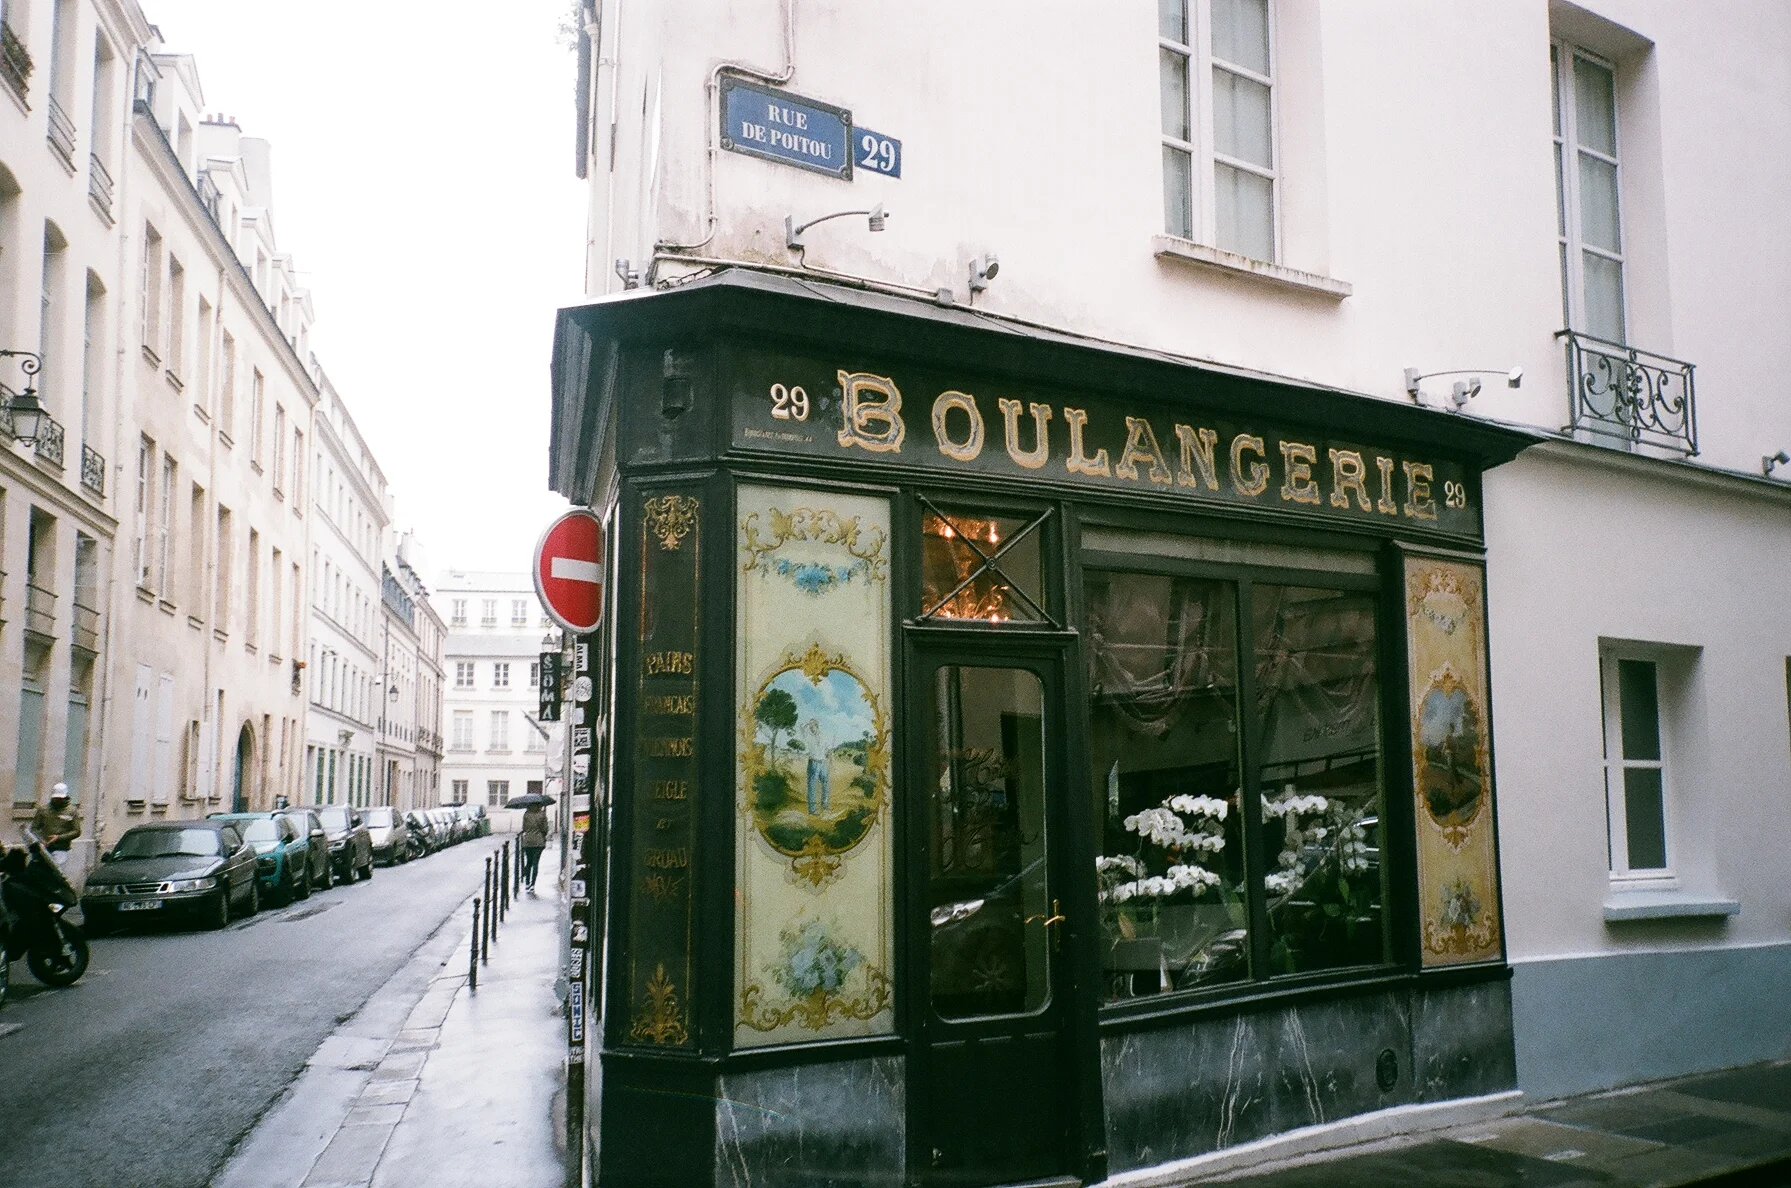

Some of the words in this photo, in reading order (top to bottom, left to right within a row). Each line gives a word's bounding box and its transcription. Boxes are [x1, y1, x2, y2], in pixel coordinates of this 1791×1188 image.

[767, 104, 807, 130] RUE
[742, 121, 767, 143] DE
[770, 129, 832, 160] POITOU
[861, 135, 896, 172] 29
[770, 383, 810, 422] 29
[837, 369, 1438, 520] BOULANGERIE
[1444, 480, 1466, 509] 29
[645, 650, 693, 675] PAINS
